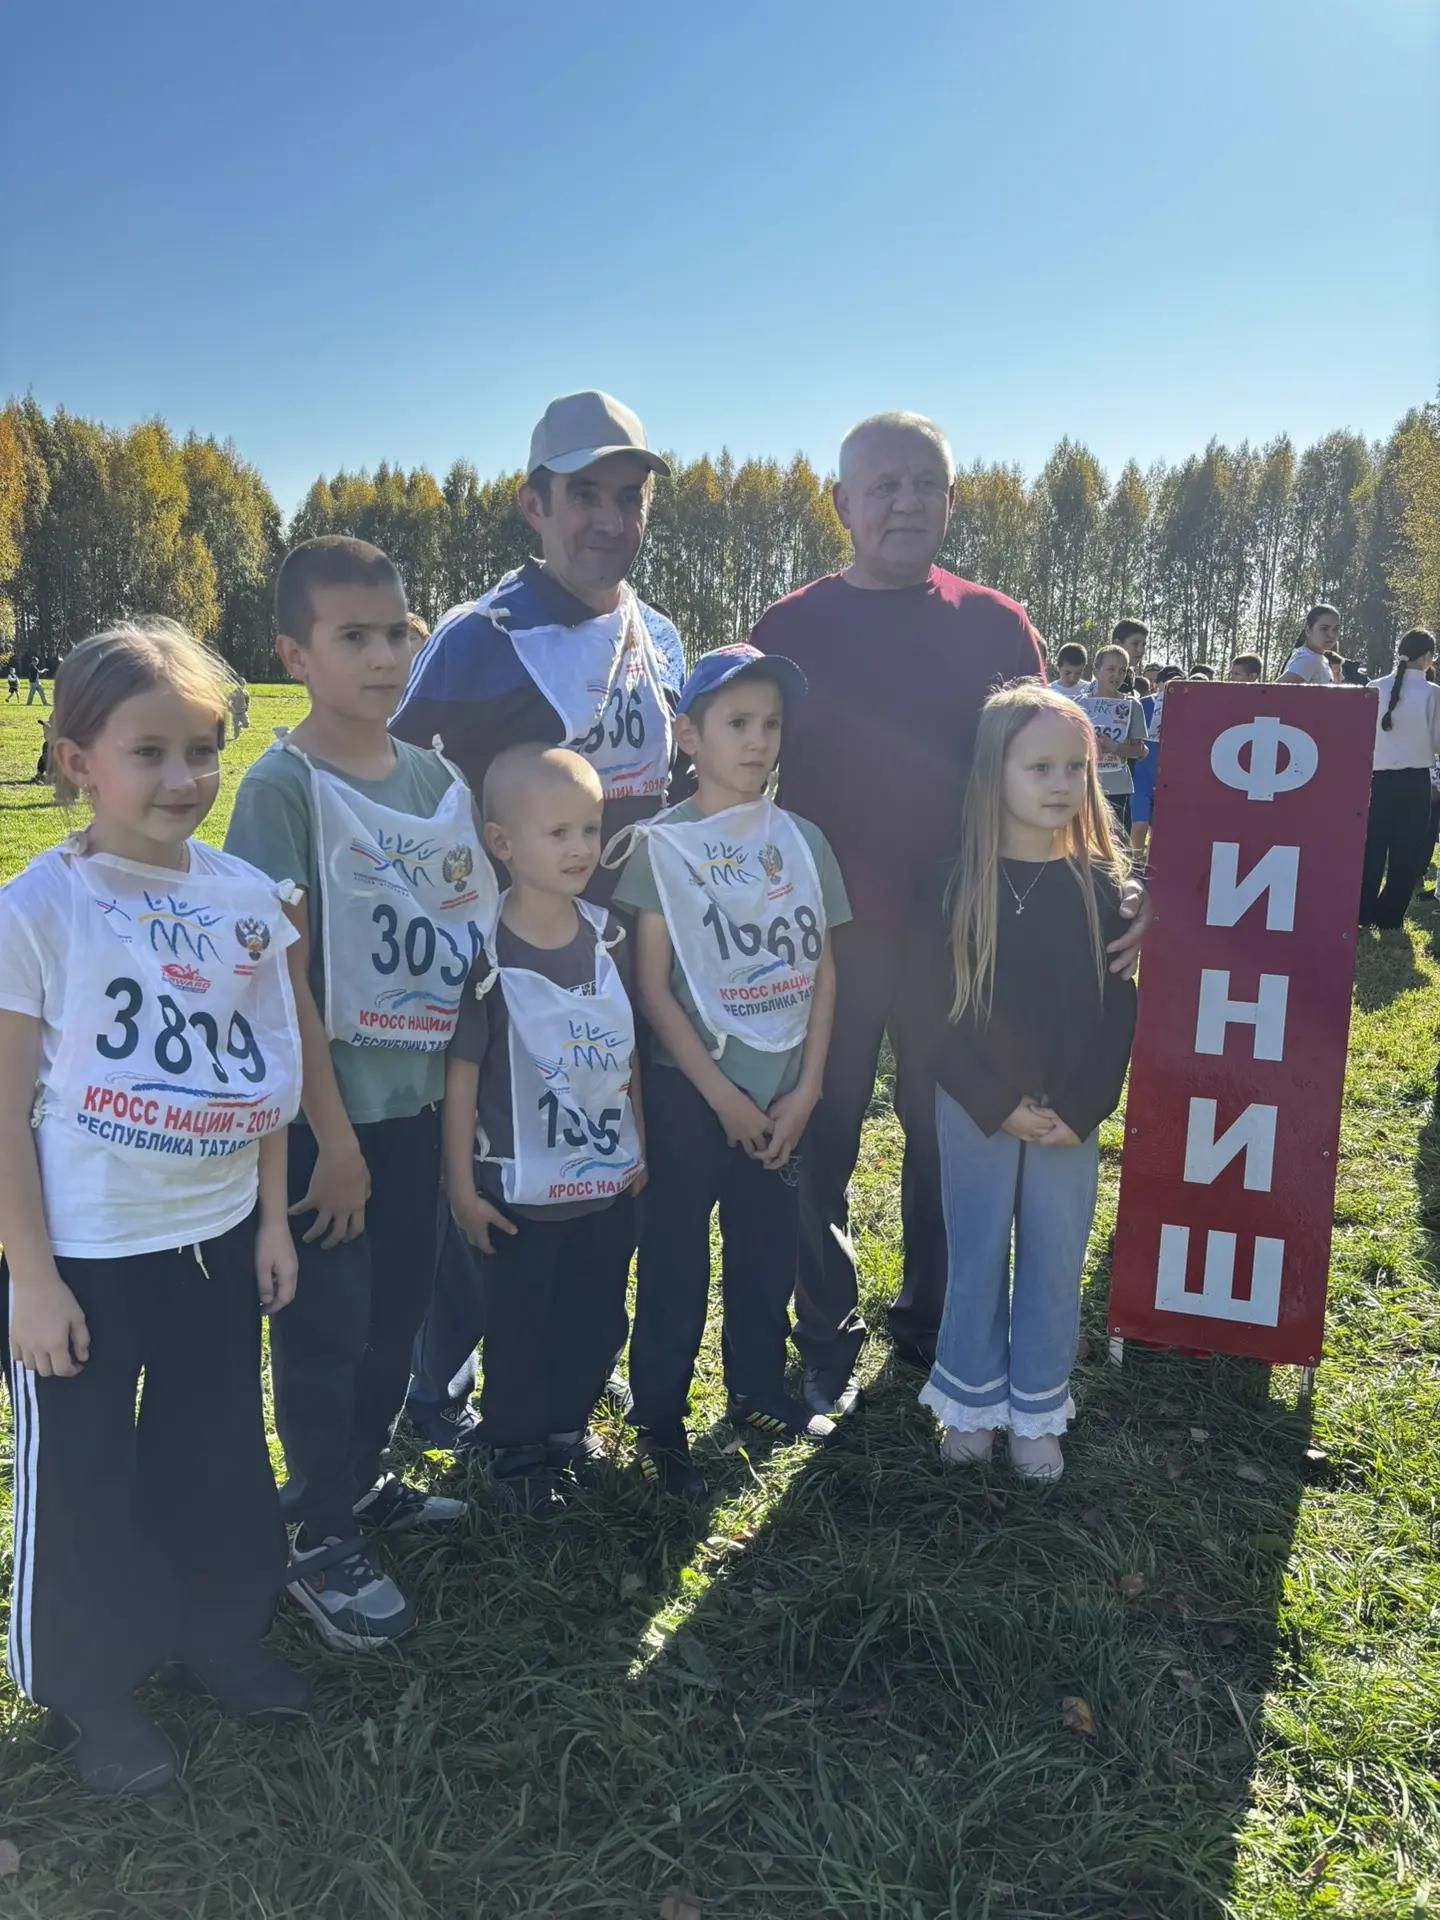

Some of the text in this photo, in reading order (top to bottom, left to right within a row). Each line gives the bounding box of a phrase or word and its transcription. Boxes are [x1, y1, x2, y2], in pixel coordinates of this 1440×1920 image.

[720, 985, 768, 1001] КРОСС
[723, 993, 798, 1017] РЕСПУБЛИКА
[359, 1009, 453, 1033] КРОСС НАЦИИ
[1155, 716, 1319, 1327] ФИНИШ
[84, 1085, 159, 1126] КРОСС
[164, 1105, 236, 1137] НАЦИИ
[247, 1106, 281, 1134] 2013
[77, 1112, 193, 1157] РЕСПУБЛИКА
[549, 1181, 593, 1200] КРОСС
